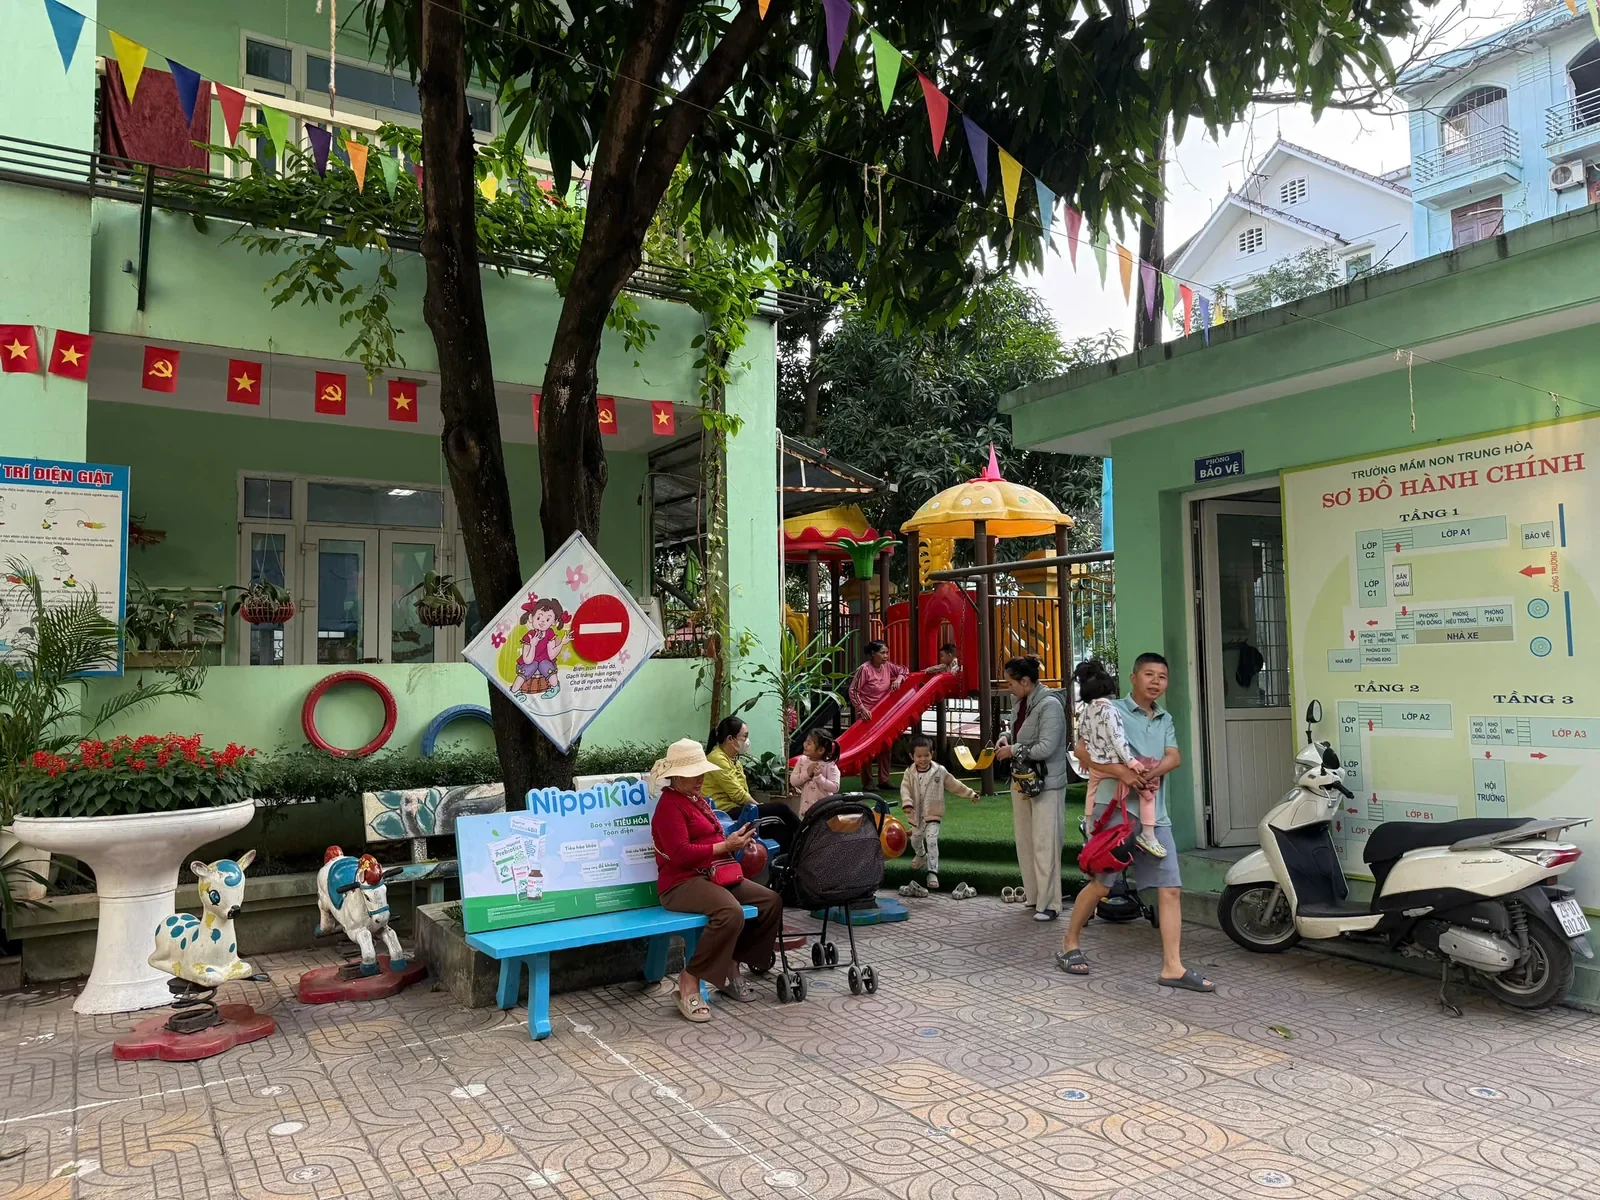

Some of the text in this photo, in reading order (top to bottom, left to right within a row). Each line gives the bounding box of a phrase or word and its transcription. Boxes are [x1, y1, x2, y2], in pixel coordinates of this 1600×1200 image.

[1206, 456, 1230, 466] PHÒNG
[1352, 440, 1533, 480] TRƯỜNG MẦM NON TRUNG HÒA
[1200, 461, 1240, 478] BẢO VỆ
[4, 463, 113, 488] TRÍ ĐIỆN GIẬT
[1322, 452, 1586, 508] SƠ ĐỒ HÀNH CHÍNH
[1400, 508, 1460, 522] TẦNG 1
[1442, 528, 1470, 538] LỚP A1
[1524, 530, 1550, 540] BẢO VỆ
[1362, 541, 1378, 550] LỚP
[1366, 550, 1376, 559] C2
[1364, 580, 1380, 588] LỚP
[1447, 631, 1465, 640] NHÀ
[1354, 680, 1420, 692] TẦNG 2
[1493, 690, 1574, 704] TẦNG 3
[1342, 715, 1356, 724] LỚP
[1402, 712, 1418, 721] LỚP
[1552, 728, 1572, 738] LỚP
[1344, 759, 1358, 768] LỚP
[1484, 782, 1496, 790] HỘI
[532, 784, 646, 817] NippiKid
[1477, 792, 1505, 802] TRƯỜNG
[1406, 810, 1422, 818] LỚP
